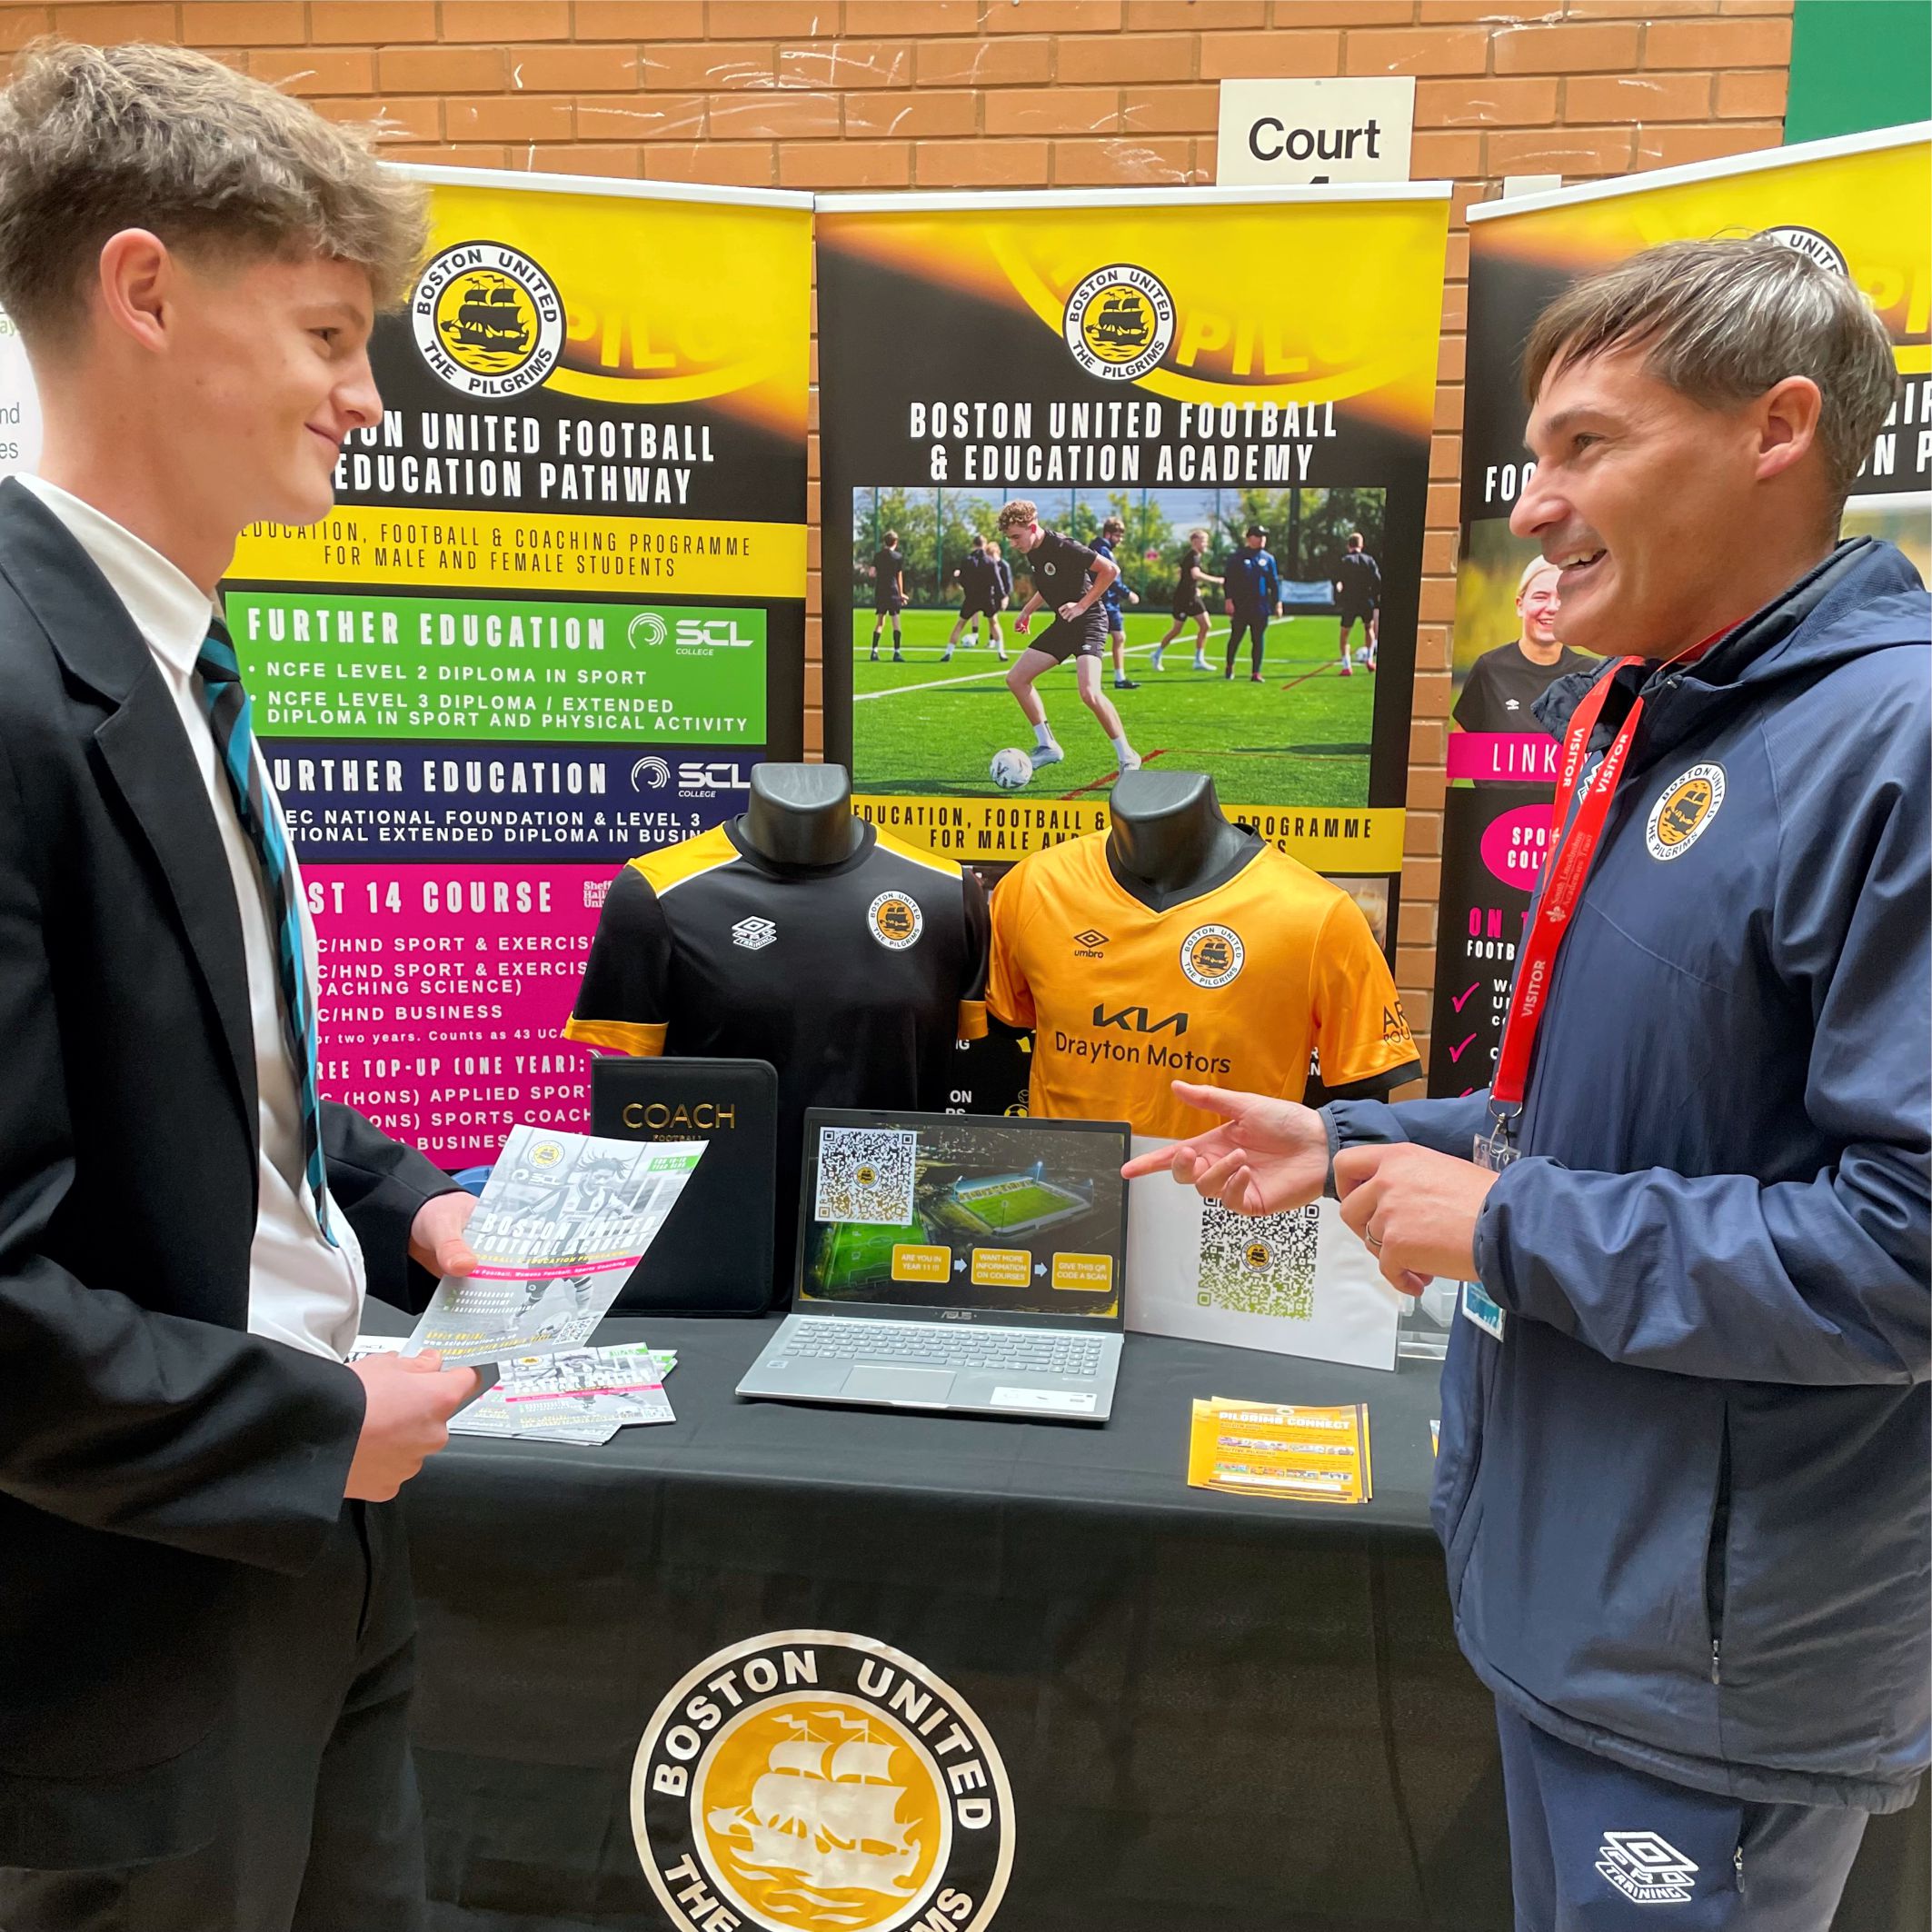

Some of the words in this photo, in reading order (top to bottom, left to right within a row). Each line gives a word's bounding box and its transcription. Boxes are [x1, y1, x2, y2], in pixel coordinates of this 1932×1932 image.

[1249, 116, 1380, 161] Court
[417, 249, 483, 315] BOSTON
[499, 252, 557, 323] UNITED
[1070, 270, 1118, 323] BOSTON
[1130, 271, 1170, 321] UNITED
[423, 341, 457, 380] THE
[468, 348, 553, 394] PILGRIMS
[1072, 340, 1096, 369] THE
[1102, 340, 1165, 377] PILGRIMS
[910, 402, 1032, 439] BOSTON
[1049, 402, 1162, 439] UNITED
[1180, 401, 1338, 439] FOOTBALL
[422, 412, 540, 453] UNITED
[558, 419, 715, 462] FOOTBALL
[930, 443, 948, 482] &
[965, 443, 1140, 482] EDUCATION
[1156, 443, 1313, 482] ACADEMY
[334, 453, 522, 498] EDUCATION
[540, 462, 692, 504] PATHWAY
[381, 523, 479, 546] FOOTBALL
[493, 528, 503, 547] &
[515, 529, 616, 552] COACHING
[630, 533, 750, 556] PROGRAMME
[324, 545, 361, 565] FOR
[374, 548, 425, 568] MALE
[439, 550, 476, 570] AND
[491, 552, 563, 573] FEMALE
[577, 554, 675, 577] STUDENTS
[248, 607, 399, 644] FURTHER
[420, 612, 604, 650] EDUCATION
[675, 620, 754, 647] SCL
[675, 648, 714, 656] COLLEGE
[267, 662, 326, 678] NCFE
[337, 663, 408, 680] LEVEL
[417, 665, 427, 680] 2
[438, 666, 535, 682] DIPLOMA
[546, 669, 566, 682] IN
[577, 670, 647, 685] SPORT
[268, 691, 327, 706] NCFE
[339, 692, 408, 708] LEVEL
[418, 694, 428, 708] 3
[440, 694, 536, 711] DIPLOMA
[546, 696, 552, 711] /
[563, 697, 673, 713] EXTENDED
[267, 709, 366, 724] DIPLOMA
[378, 711, 398, 725] IN
[409, 712, 480, 727] SPORT
[490, 713, 531, 728] AND
[542, 714, 645, 730] PHYSICAL
[654, 717, 748, 732] ACTIVITY
[1492, 743, 1558, 773] LINK
[1562, 728, 1586, 788] VISITOR
[1595, 733, 1628, 793] VISITOR
[273, 759, 403, 792] URTHER
[423, 761, 605, 793] EDUCATION
[678, 763, 752, 789] SCL
[678, 790, 716, 798] COLLEGE
[1662, 767, 1712, 801] BOSTON
[1708, 771, 1723, 818] UNITED
[324, 810, 435, 825] NATIONAL
[446, 811, 583, 826] FOUNDATION
[594, 812, 606, 826] &
[617, 812, 682, 827] LEVEL
[691, 812, 701, 827] 3
[985, 808, 1081, 830] FOOTBALL
[1095, 812, 1105, 831] &
[289, 827, 368, 842] TIONAL
[380, 827, 493, 842] EXTENDED
[504, 828, 599, 842] DIPLOMA
[610, 829, 629, 842] IN
[930, 829, 965, 848] FOR
[978, 830, 1029, 850] MALE
[1648, 817, 1658, 842] THE
[1653, 832, 1698, 858] PILGRIMS
[366, 881, 402, 914] 14
[423, 881, 552, 914] COURSE
[870, 892, 893, 918] BOSTON
[898, 893, 921, 920] UNITED
[1469, 908, 1502, 938] ON
[317, 939, 383, 953] C/HND
[393, 937, 465, 952] SPORT
[475, 937, 488, 951] &
[873, 927, 886, 941] THE
[890, 928, 921, 947] PILGRIMS
[1184, 927, 1215, 952] BOSTON
[1220, 929, 1242, 959] UNITED
[1074, 949, 1104, 959] umbro
[317, 964, 383, 979] C/HND
[393, 963, 465, 978] SPORT
[475, 962, 488, 976] &
[1184, 961, 1197, 979] THE
[1200, 967, 1238, 986] PILGRIMS
[420, 980, 522, 996] SCIENCE)
[1521, 960, 1547, 1017] VISITOR
[318, 1007, 384, 1021] C/HND
[395, 1005, 503, 1021] BUSINESS
[1092, 1002, 1189, 1037] KIA
[338, 1032, 364, 1043] two
[373, 1031, 421, 1045] years.
[428, 1030, 483, 1041] Counts
[491, 1031, 506, 1041] as
[514, 1029, 531, 1039] 43
[1055, 1031, 1140, 1063] Drayton
[1147, 1044, 1231, 1074] Motors
[363, 1058, 441, 1079] TOP-UP
[455, 1056, 502, 1075] (ONE
[515, 1054, 585, 1074] YEAR):
[344, 1089, 420, 1106] (HONS)
[430, 1087, 520, 1102] APPLIED
[431, 1110, 513, 1127] SPORTS
[622, 1102, 735, 1129] COACH
[481, 1213, 572, 1240] BOSTON
[579, 1216, 657, 1240] UNITED
[473, 1233, 561, 1256] FOOTBALL
[562, 1232, 649, 1255] ACADEMY
[901, 1254, 915, 1262] ARE
[917, 1255, 932, 1263] YOU
[902, 1262, 921, 1270] YEAR
[976, 1262, 1027, 1271] INFORMATION
[980, 1254, 1001, 1262] WANT
[1002, 1255, 1024, 1263] MORE
[1059, 1262, 1076, 1270] GIVE
[1077, 1263, 1091, 1271] THIS
[1093, 1263, 1106, 1272] QR
[990, 1271, 1025, 1280] COURSES
[1057, 1271, 1079, 1280] CODE
[1087, 1272, 1108, 1281] SCAN
[941, 1310, 972, 1320] ASUS
[1287, 1418, 1350, 1429] CONNECT
[652, 1649, 818, 1798] BOSTON
[857, 1658, 992, 1830] UNITED
[664, 1853, 742, 1932] THE
[1606, 1867, 1682, 1899] TRAINING
